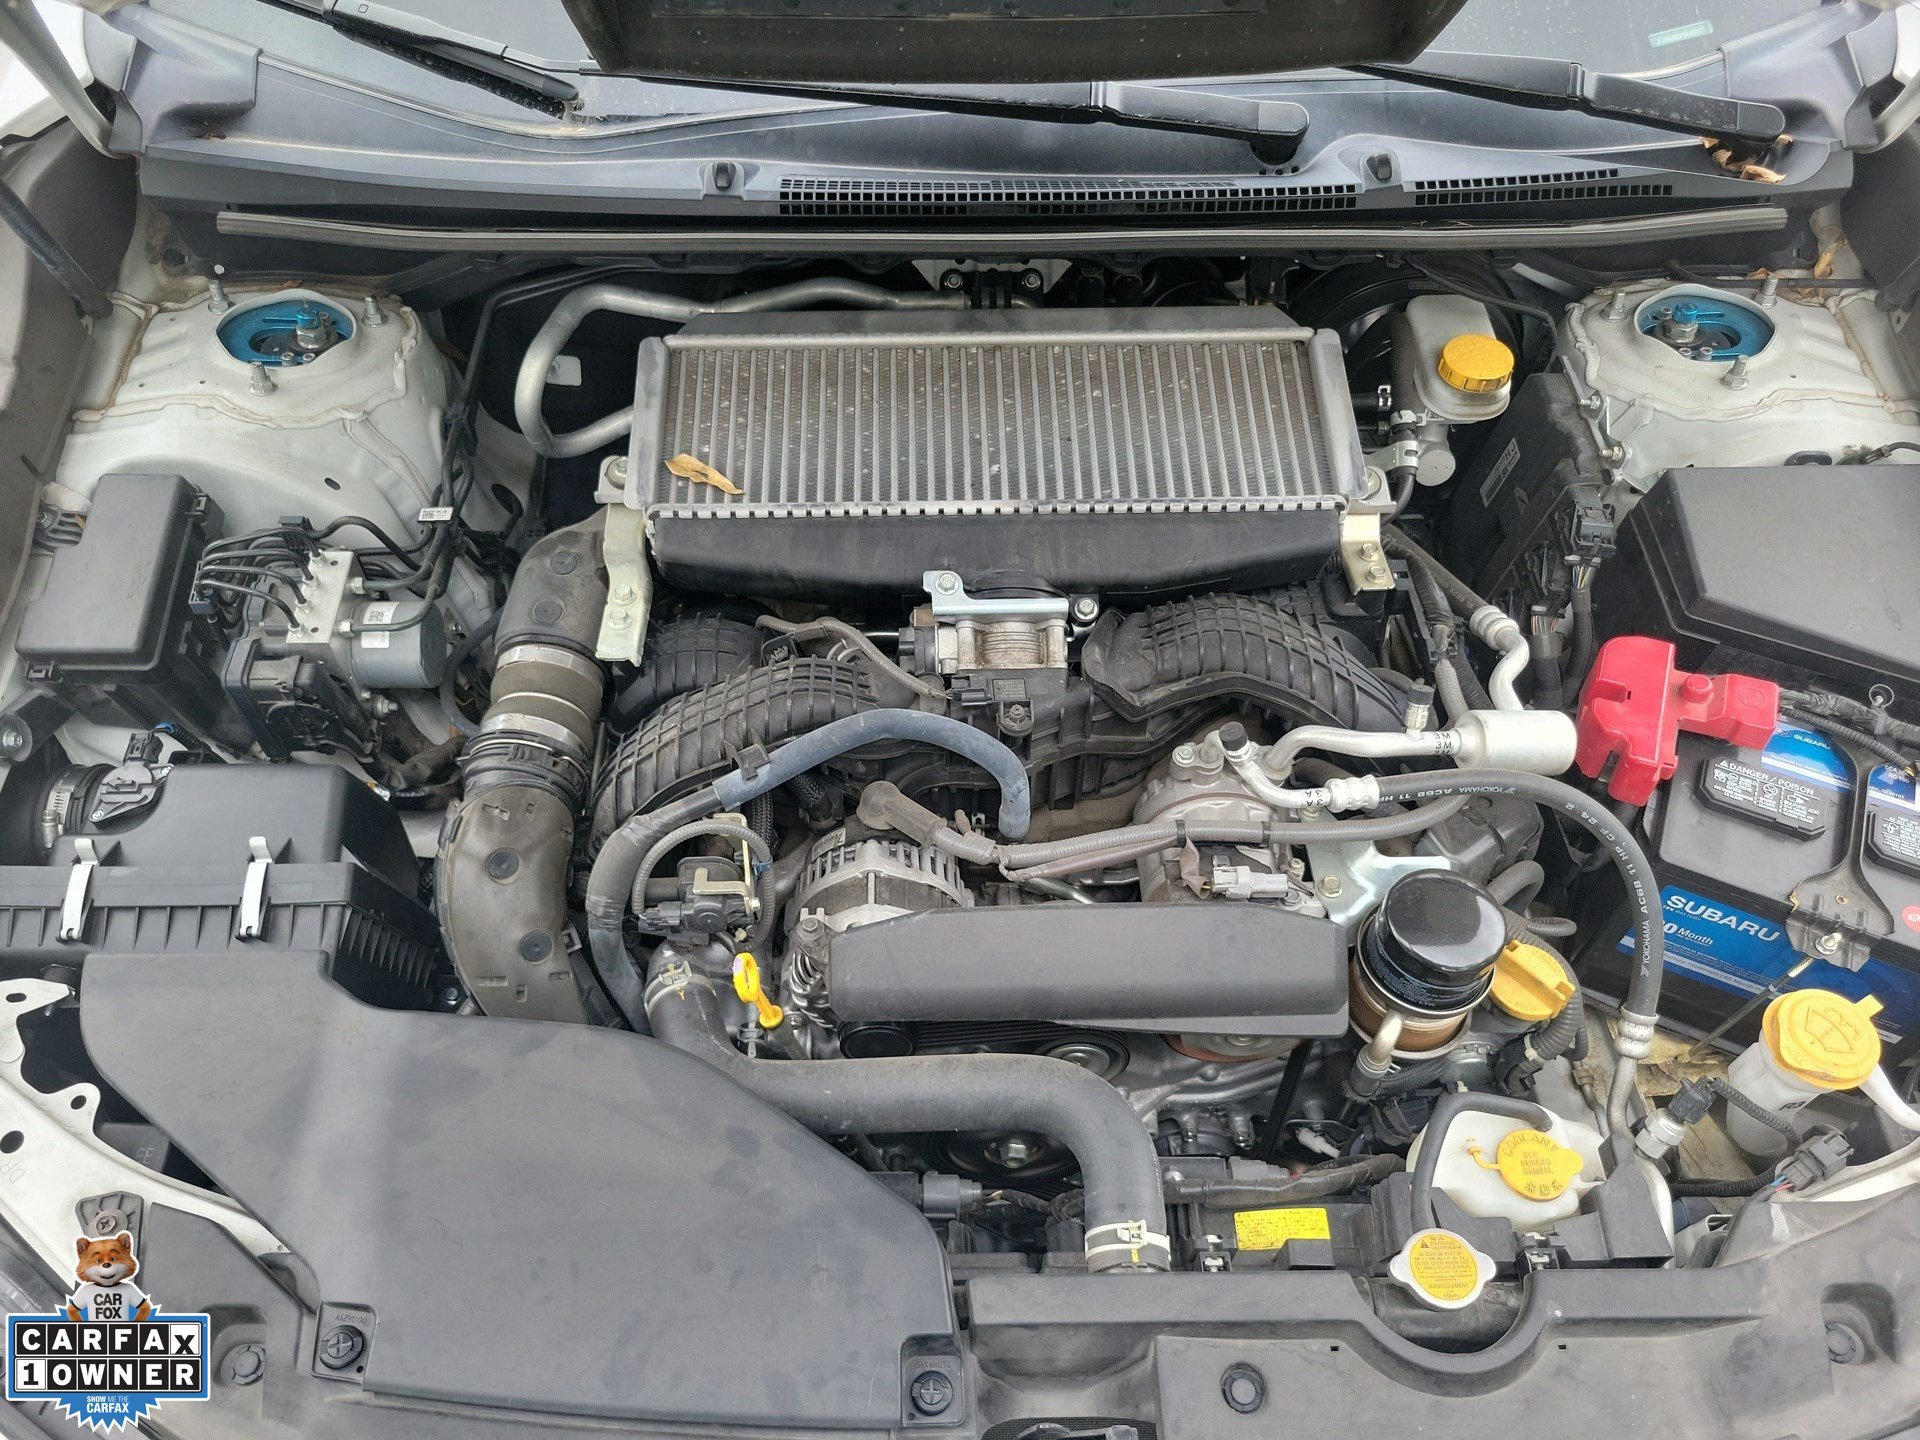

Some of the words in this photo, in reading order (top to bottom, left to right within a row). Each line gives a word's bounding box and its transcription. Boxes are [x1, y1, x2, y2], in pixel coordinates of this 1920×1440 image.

[1433, 731, 1451, 740] 3M
[1793, 734, 1831, 750] SUBARU
[1435, 740, 1452, 750] 3M
[1729, 763, 1769, 781] DANGER
[1778, 778, 1815, 796] POISON
[1458, 786, 1503, 794] YOKOHAMA
[1614, 845, 1629, 861] HP
[1626, 863, 1637, 876] 11
[1666, 895, 1781, 942] SUBARU
[1662, 920, 1679, 934] 0
[1677, 927, 1714, 946] Month
[1641, 919, 1651, 965] YOKOHAMA
[1502, 1133, 1559, 1157] COOLANT
